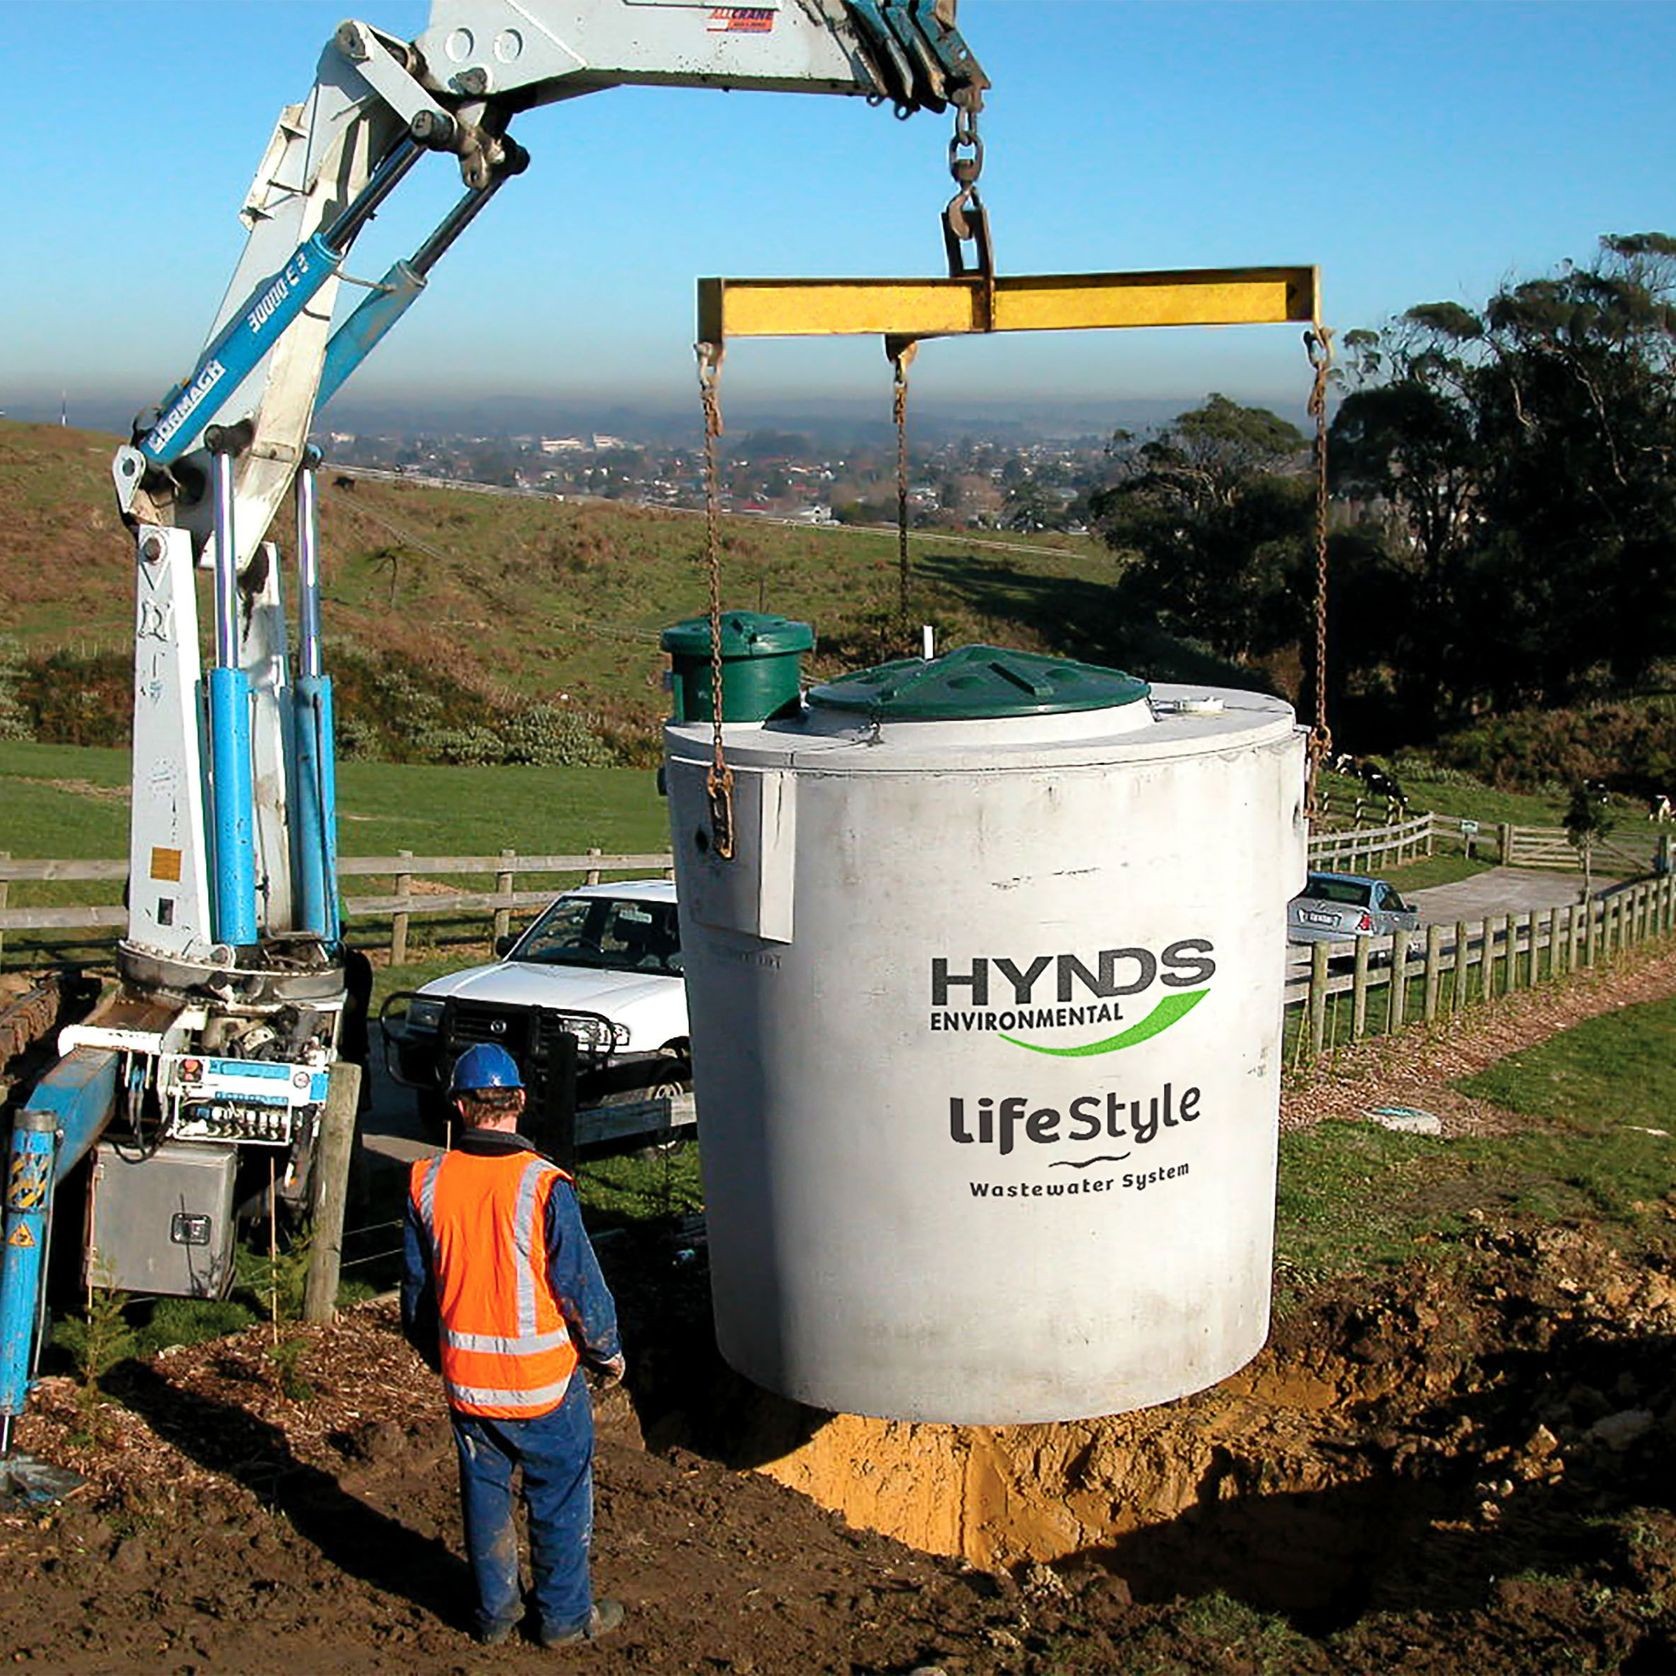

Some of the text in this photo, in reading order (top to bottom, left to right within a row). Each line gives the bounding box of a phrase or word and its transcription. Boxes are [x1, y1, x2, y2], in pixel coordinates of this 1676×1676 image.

[931, 938, 1216, 1006] HYNDS
[930, 1002, 1124, 1031] ENVIRONMENTAL
[969, 1162, 1190, 1197] Wastewater System
